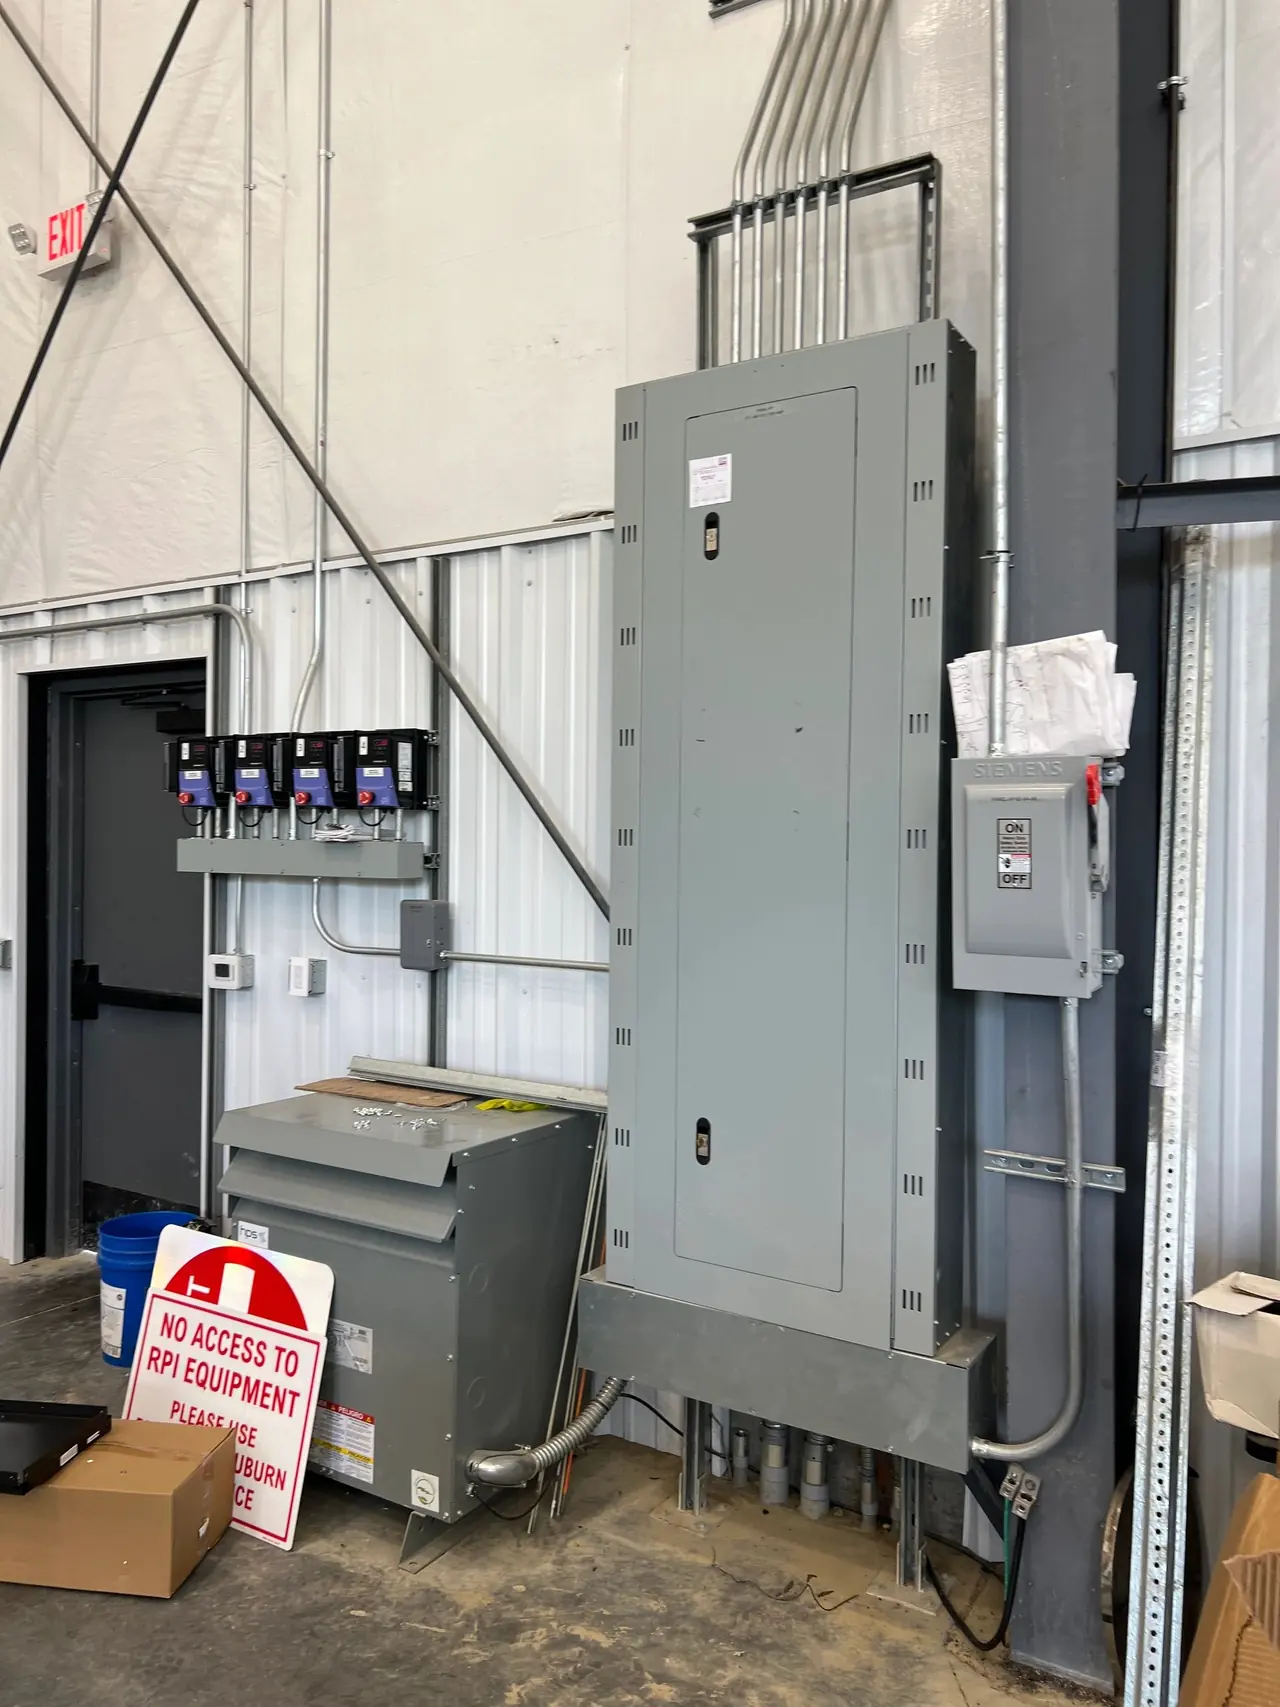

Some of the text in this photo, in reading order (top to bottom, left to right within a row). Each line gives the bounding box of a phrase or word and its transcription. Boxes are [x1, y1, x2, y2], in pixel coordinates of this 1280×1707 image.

[49, 203, 85, 260] EXIT
[973, 761, 1063, 778] SIEMENS
[1005, 823, 1024, 833] ON
[1002, 874, 1027, 884] OFF
[160, 1312, 187, 1342] NO
[191, 1322, 267, 1367] ACCESS
[275, 1345, 299, 1377] TO
[147, 1346, 301, 1418] RPI EQUIPMENT
[170, 1400, 225, 1428] PLEASE
[234, 1453, 287, 1491] UBURN
